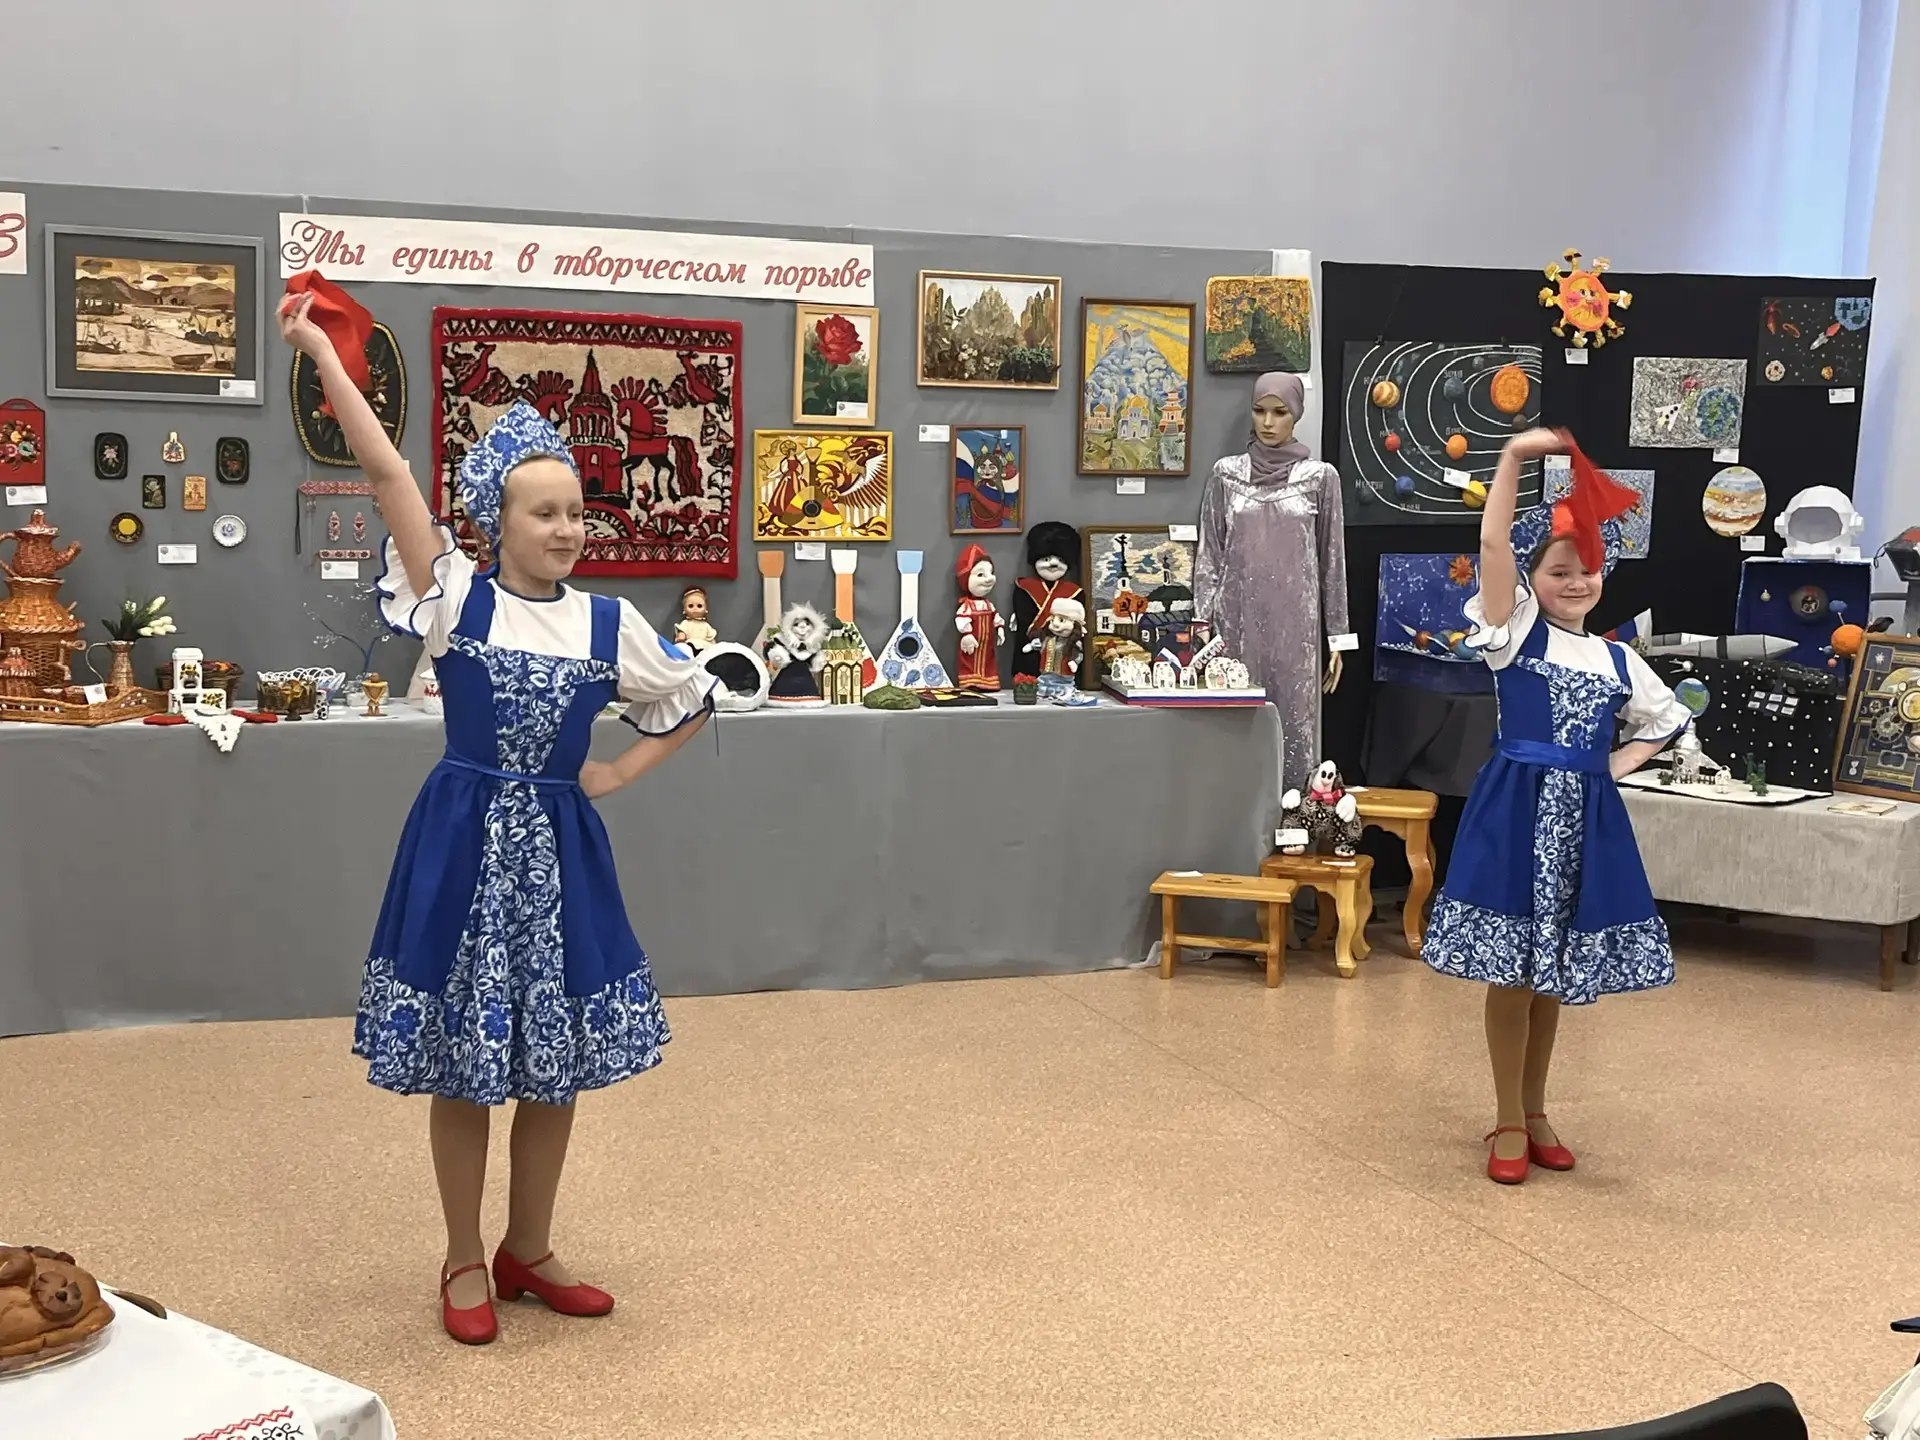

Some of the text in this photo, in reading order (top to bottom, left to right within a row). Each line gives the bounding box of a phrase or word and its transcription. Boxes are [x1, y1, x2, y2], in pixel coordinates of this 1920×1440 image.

[282, 221, 872, 293] Мы едины в творческом порыве
